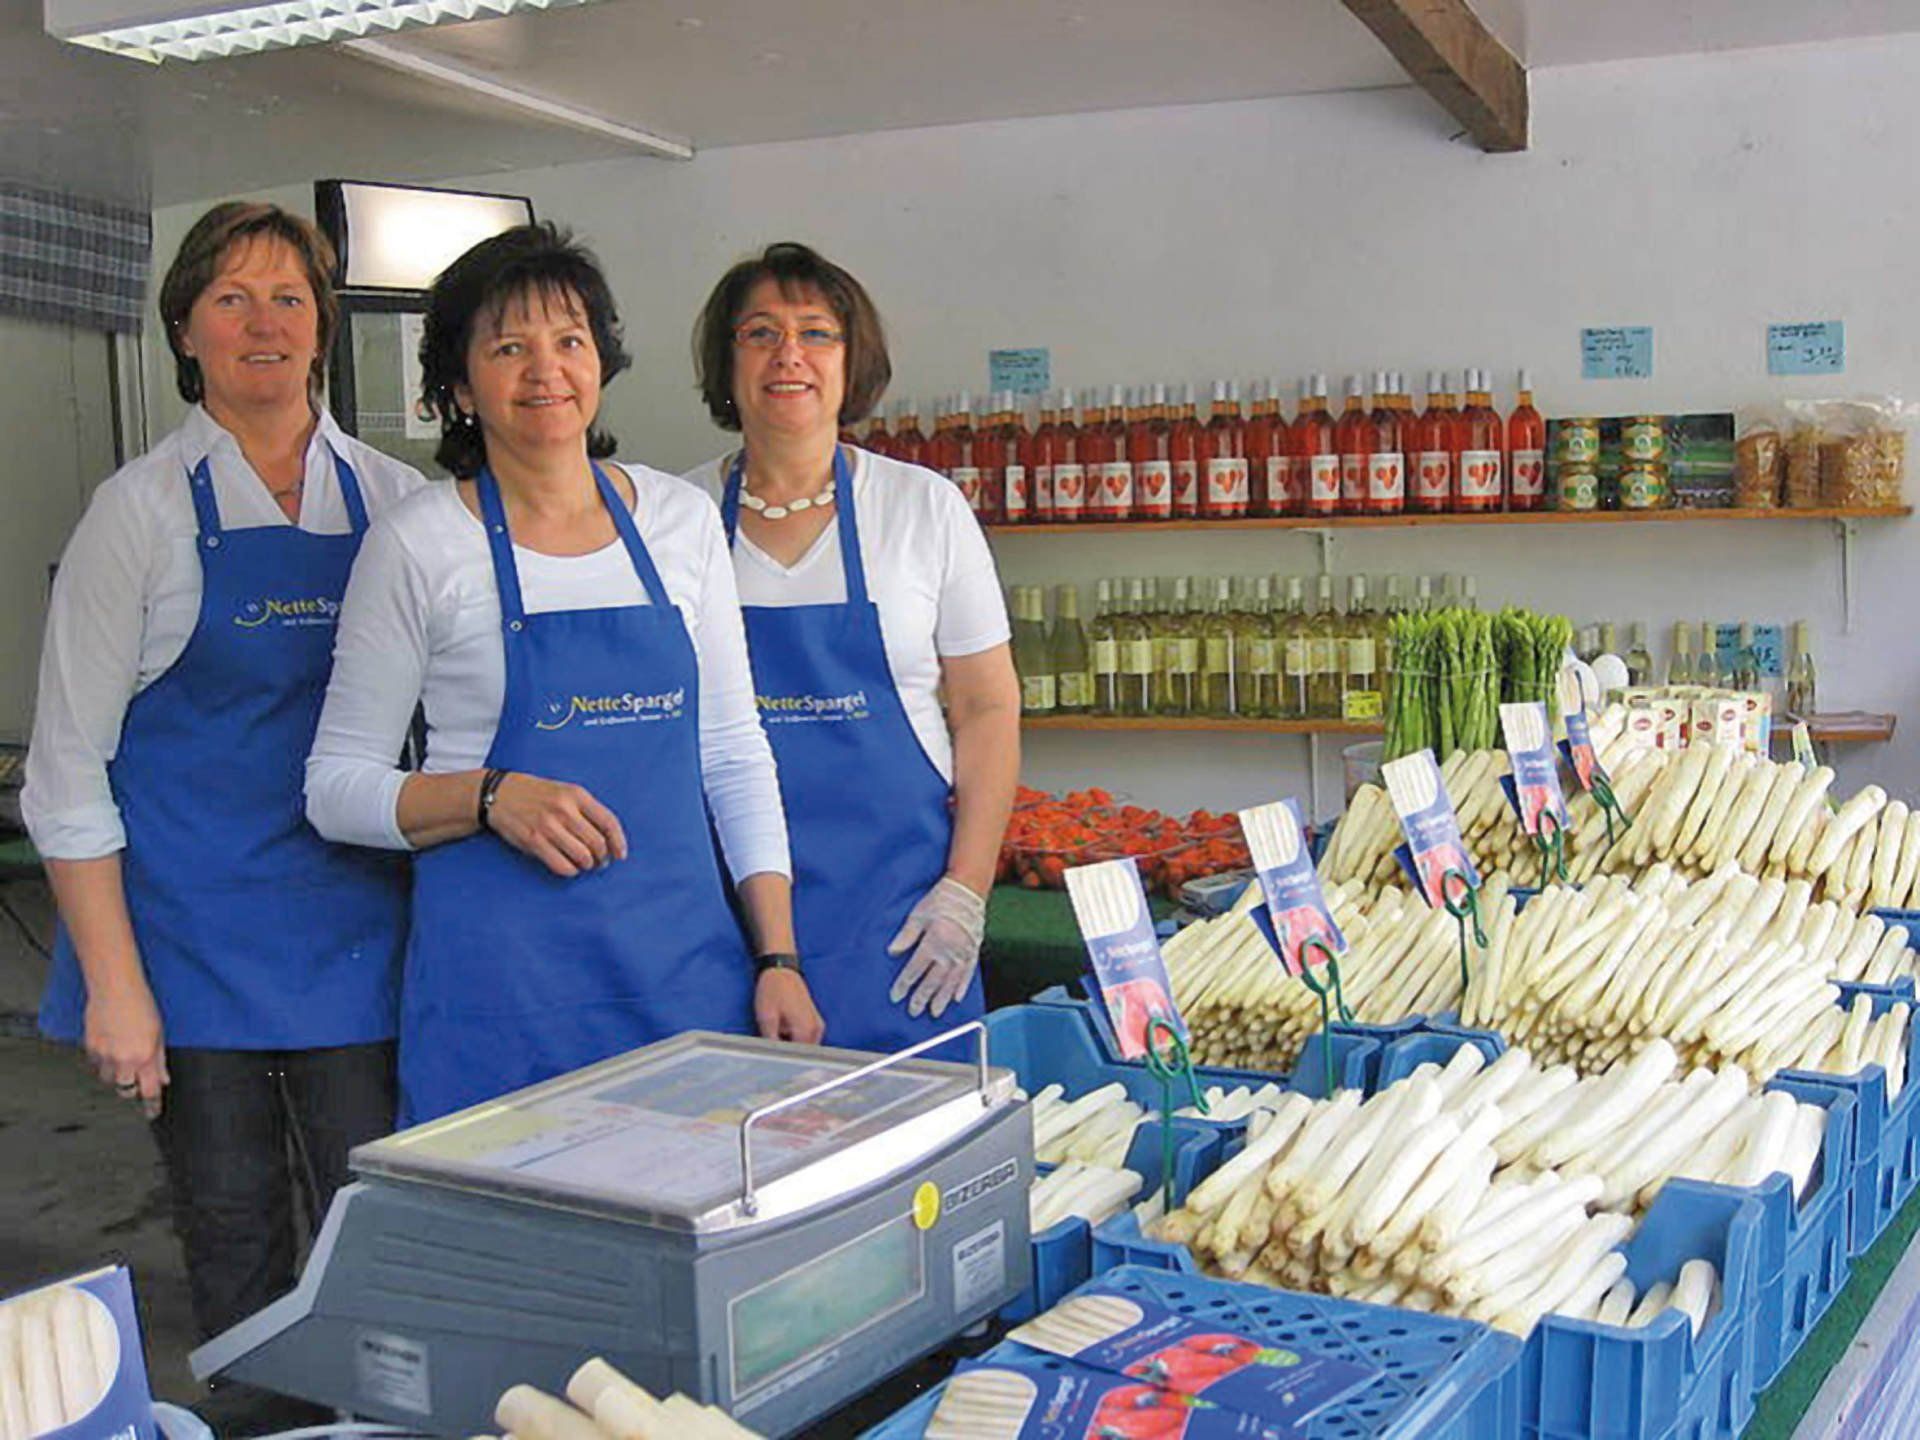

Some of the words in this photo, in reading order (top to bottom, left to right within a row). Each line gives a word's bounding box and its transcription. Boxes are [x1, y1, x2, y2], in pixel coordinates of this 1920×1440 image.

[573, 688, 684, 713] NetteSpargel
[755, 691, 867, 713] NetteSpargel
[945, 1162, 1016, 1212] BIZERBA
